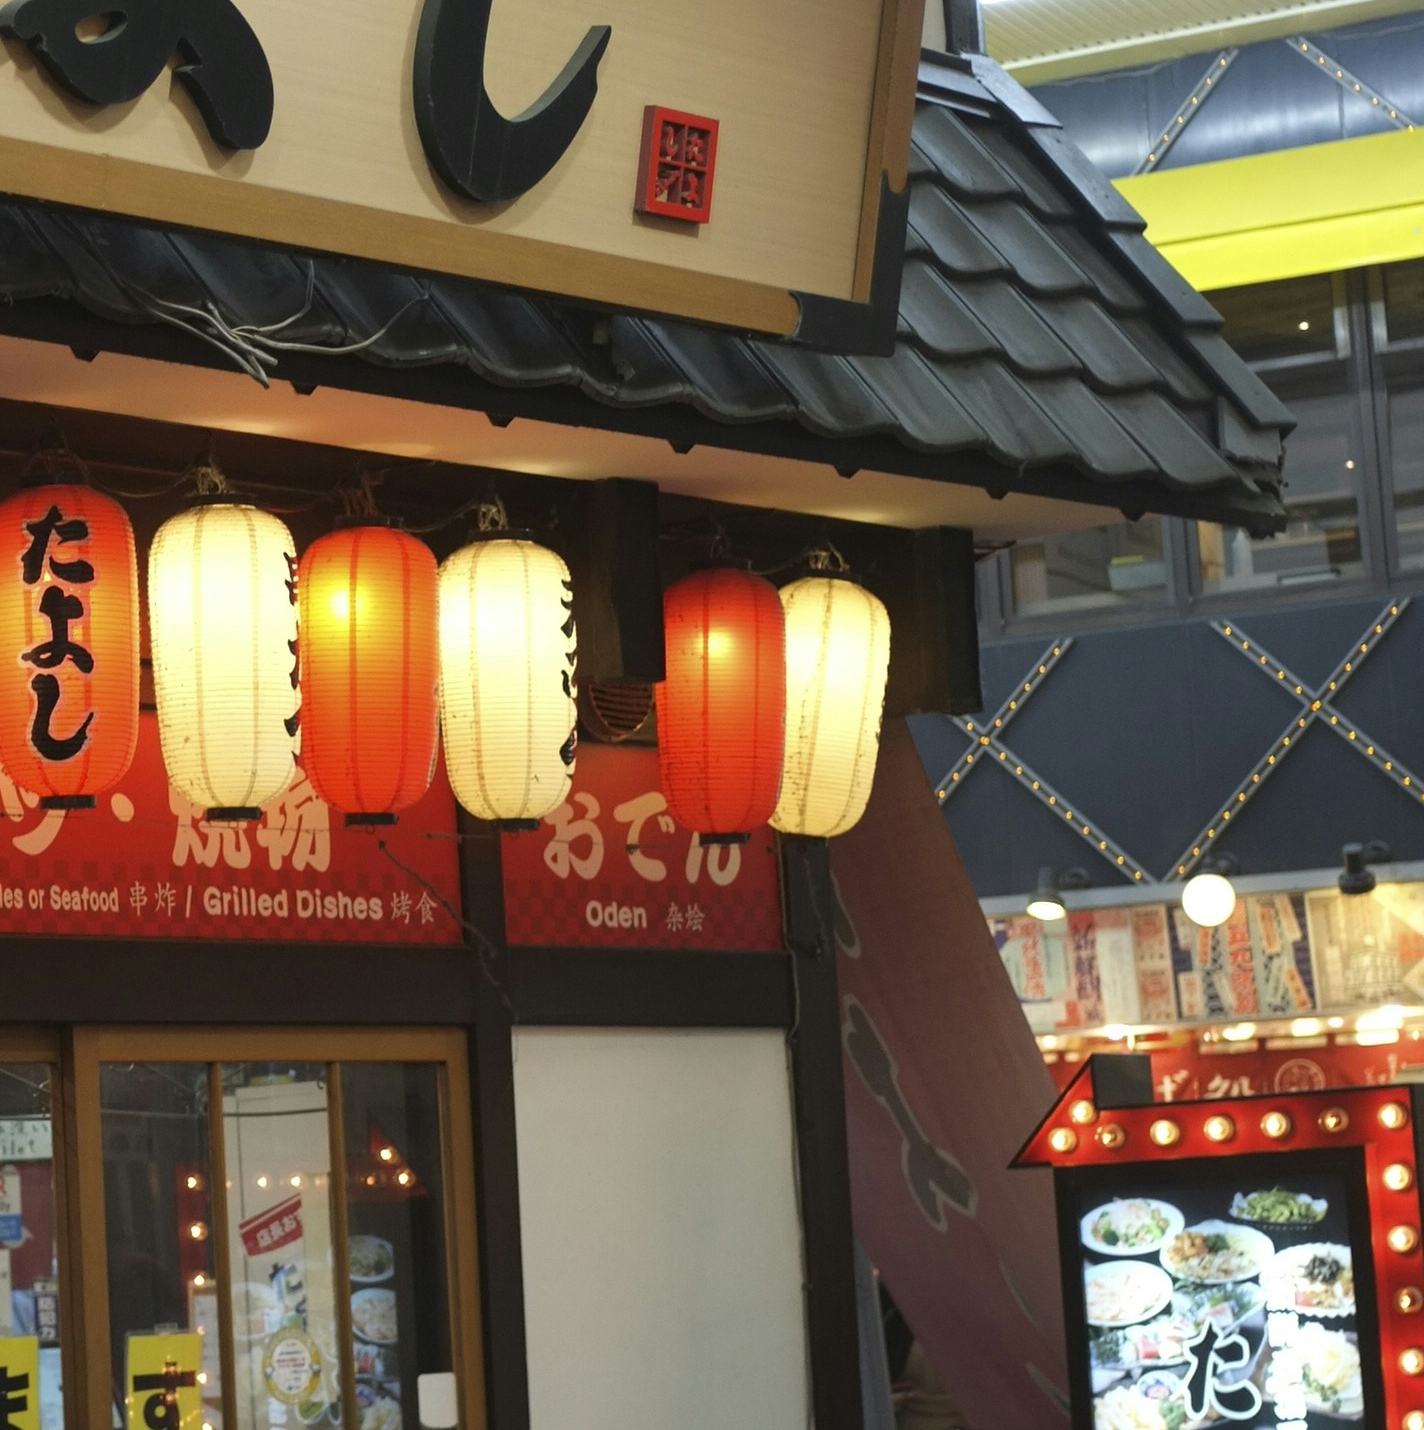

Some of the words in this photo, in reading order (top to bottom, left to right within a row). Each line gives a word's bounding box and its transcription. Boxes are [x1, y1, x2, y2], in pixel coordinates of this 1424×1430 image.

[19, 505, 95, 761] たよし
[28, 889, 44, 910] or
[49, 884, 119, 913] Seafood
[203, 886, 289, 918] Grilled
[296, 889, 384, 921] Dishes
[586, 900, 647, 929] Oden
